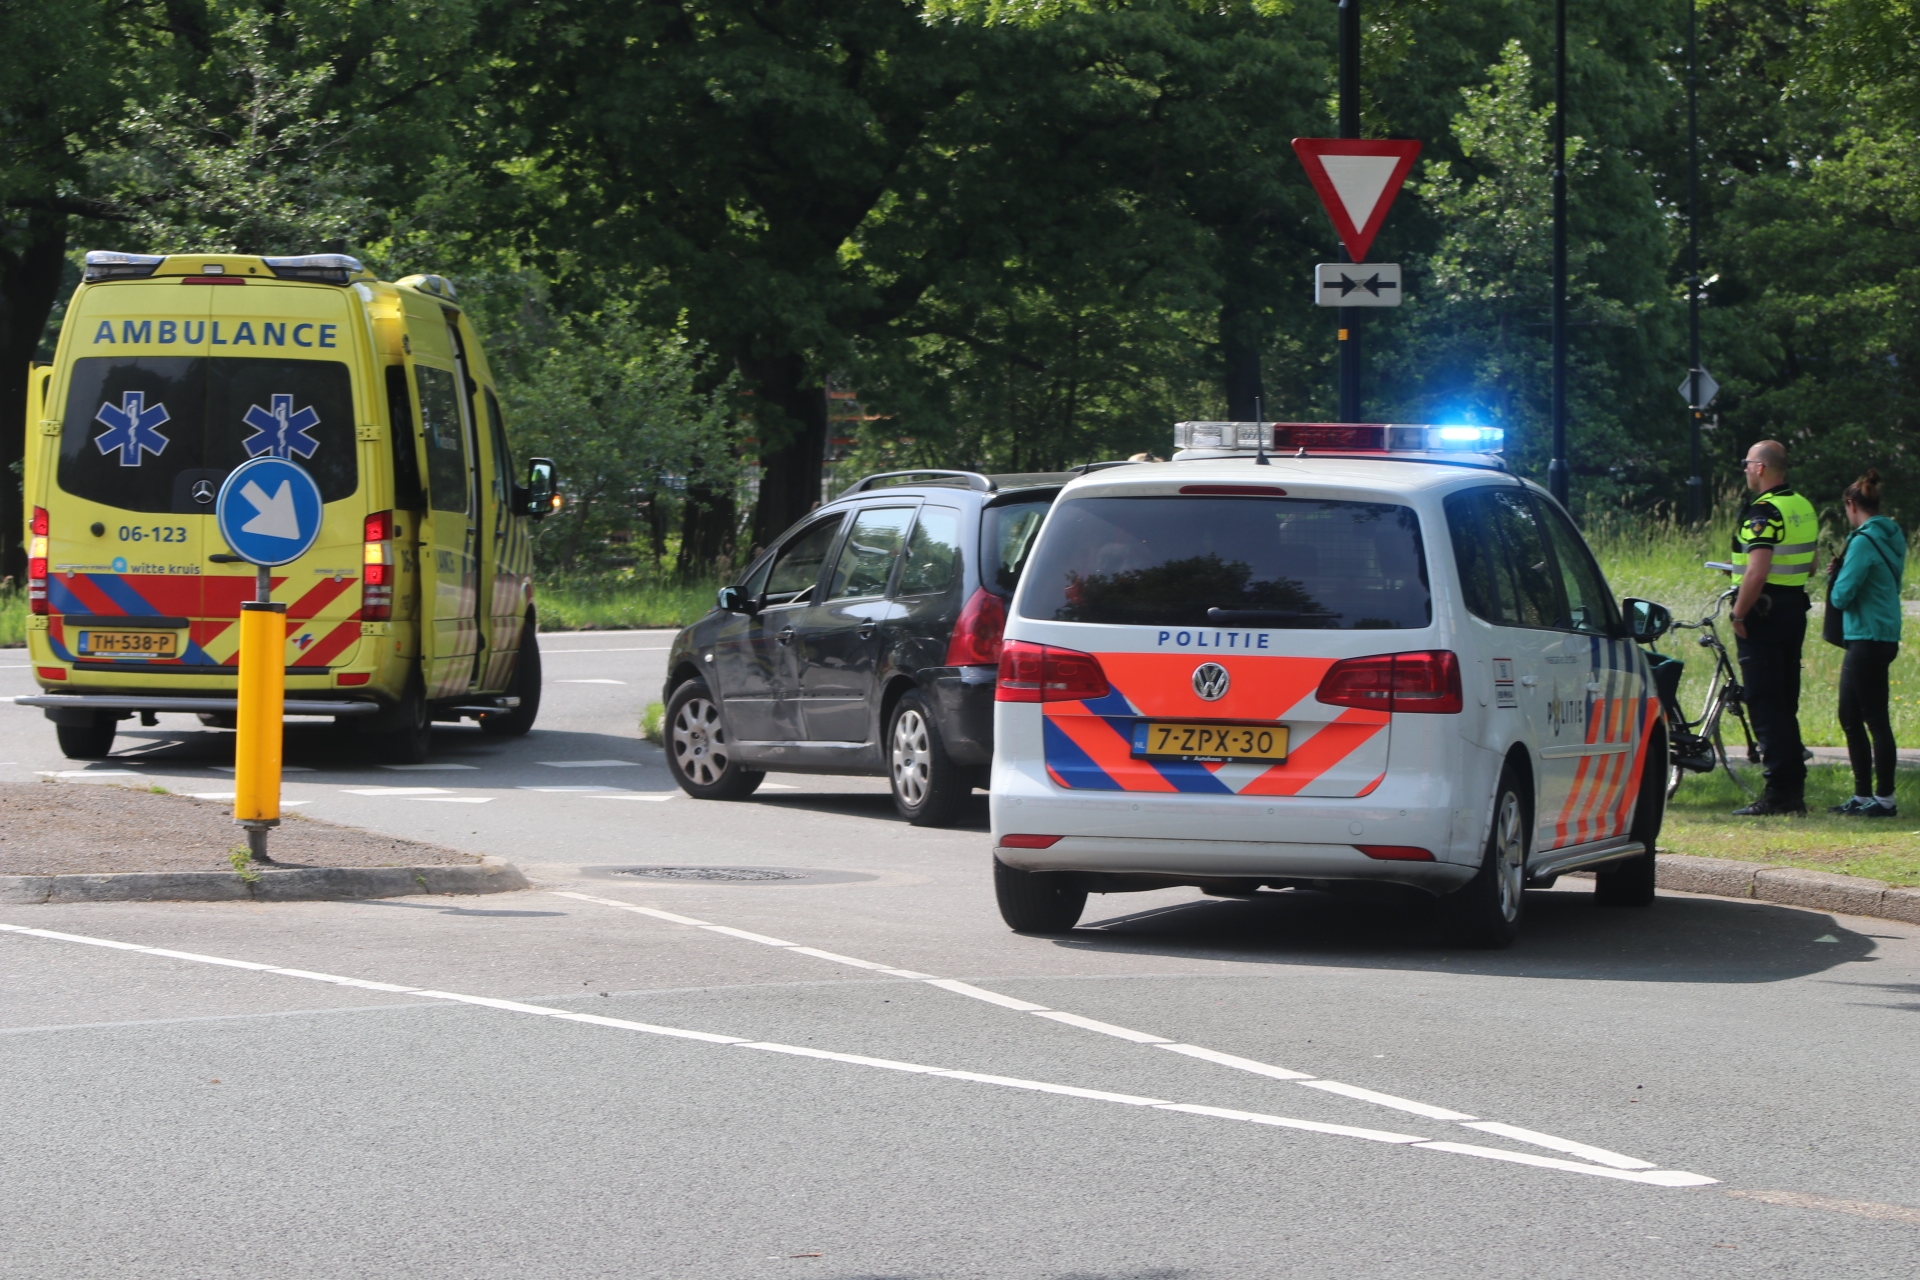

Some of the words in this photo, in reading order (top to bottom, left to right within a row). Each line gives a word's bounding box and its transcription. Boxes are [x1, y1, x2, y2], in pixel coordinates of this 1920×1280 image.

[93, 320, 337, 348] AMBULANCE
[118, 526, 187, 542] 06-123
[131, 563, 165, 574] witte
[168, 564, 201, 574] kruis
[94, 635, 169, 650] TH-538-P
[1157, 631, 1269, 648] POLITIE
[1134, 741, 1146, 749] NL
[1157, 728, 1273, 753] 7-ZPX-30
